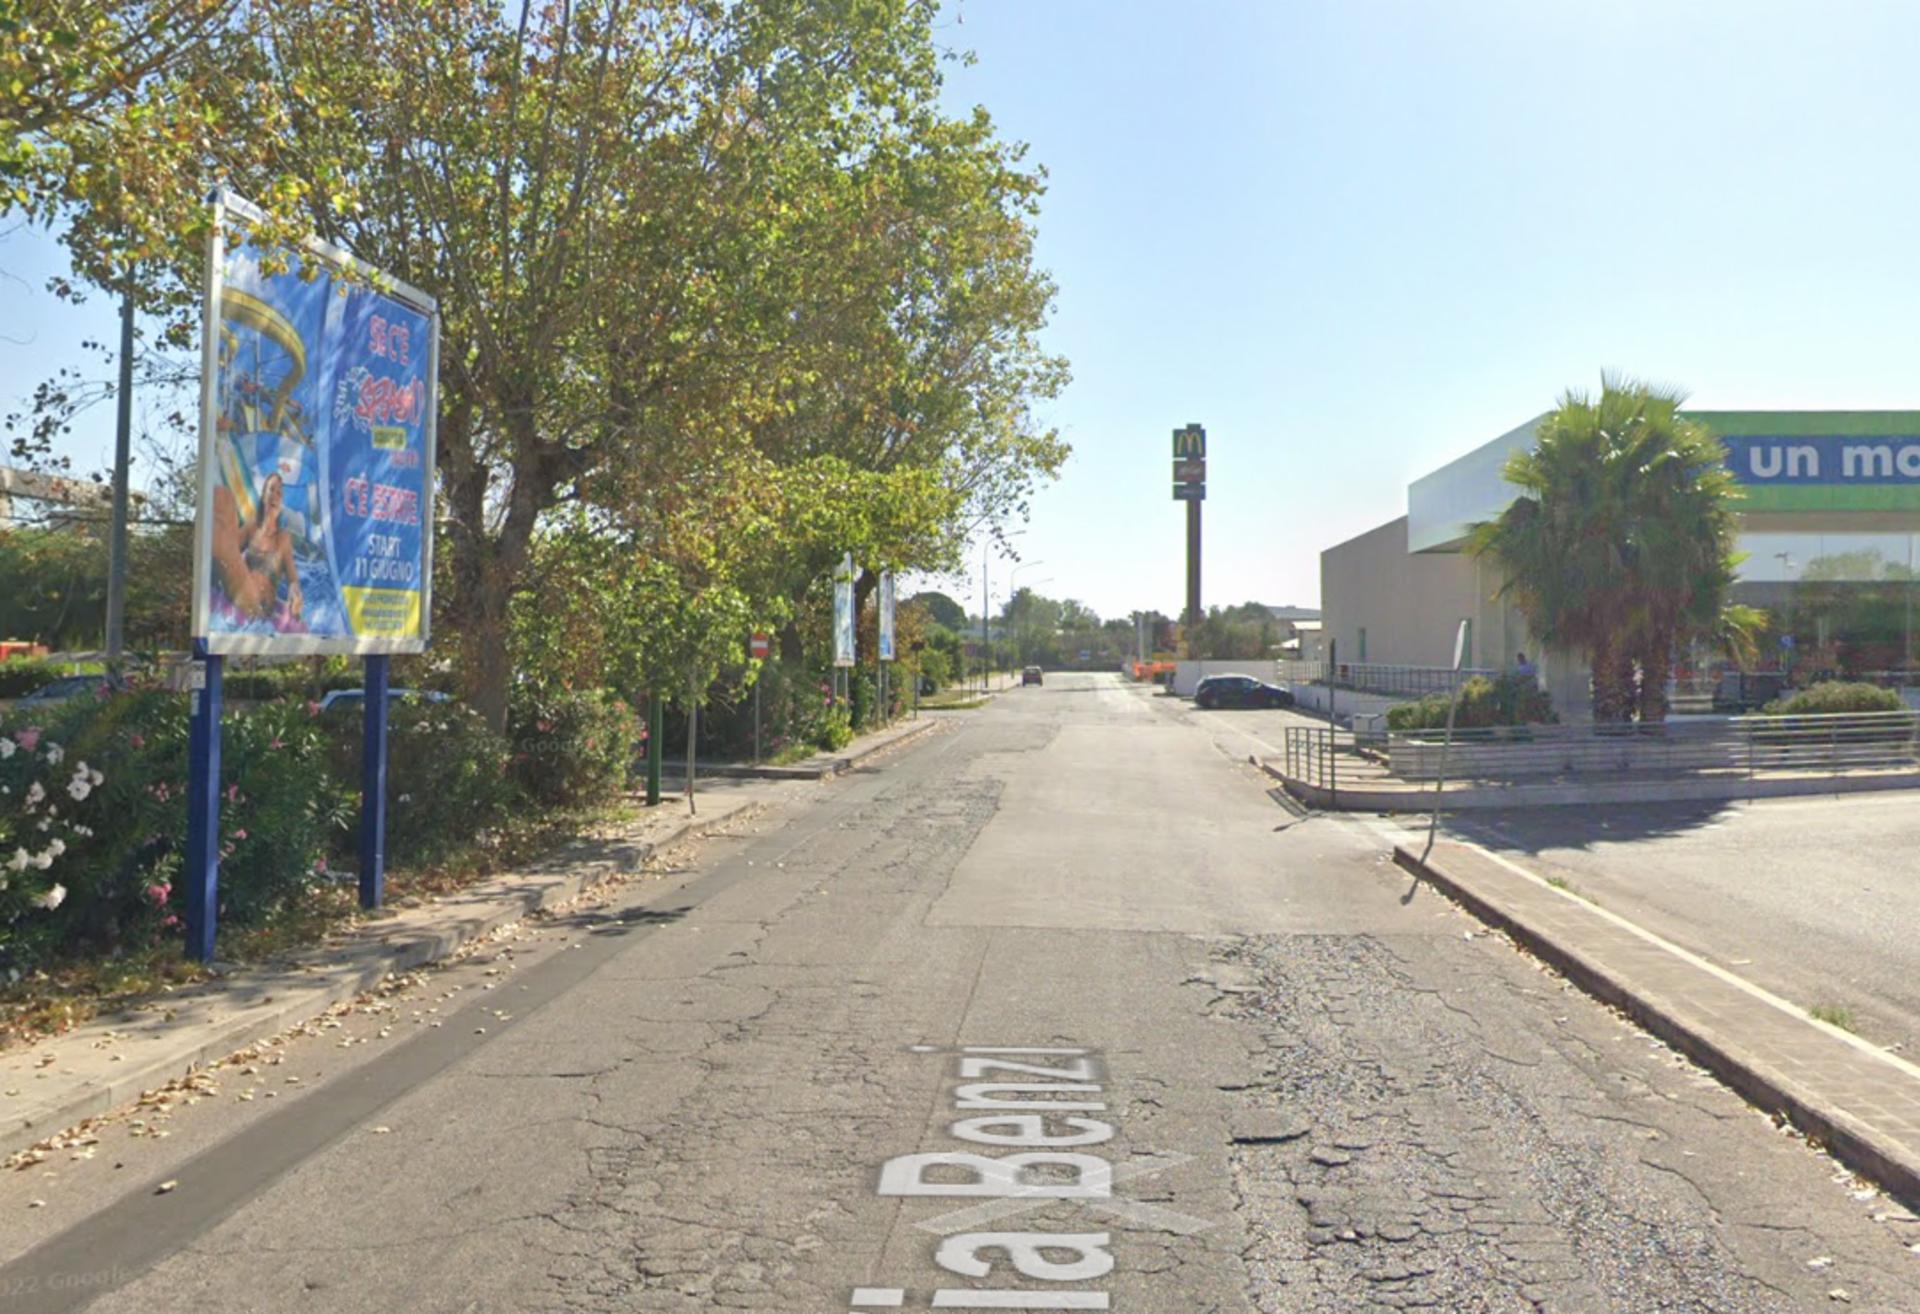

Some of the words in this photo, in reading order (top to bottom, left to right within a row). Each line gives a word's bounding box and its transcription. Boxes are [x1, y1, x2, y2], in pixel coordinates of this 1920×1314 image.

[1750, 445, 1819, 478] un
[368, 533, 402, 557] START
[369, 559, 414, 582] GIUGNO
